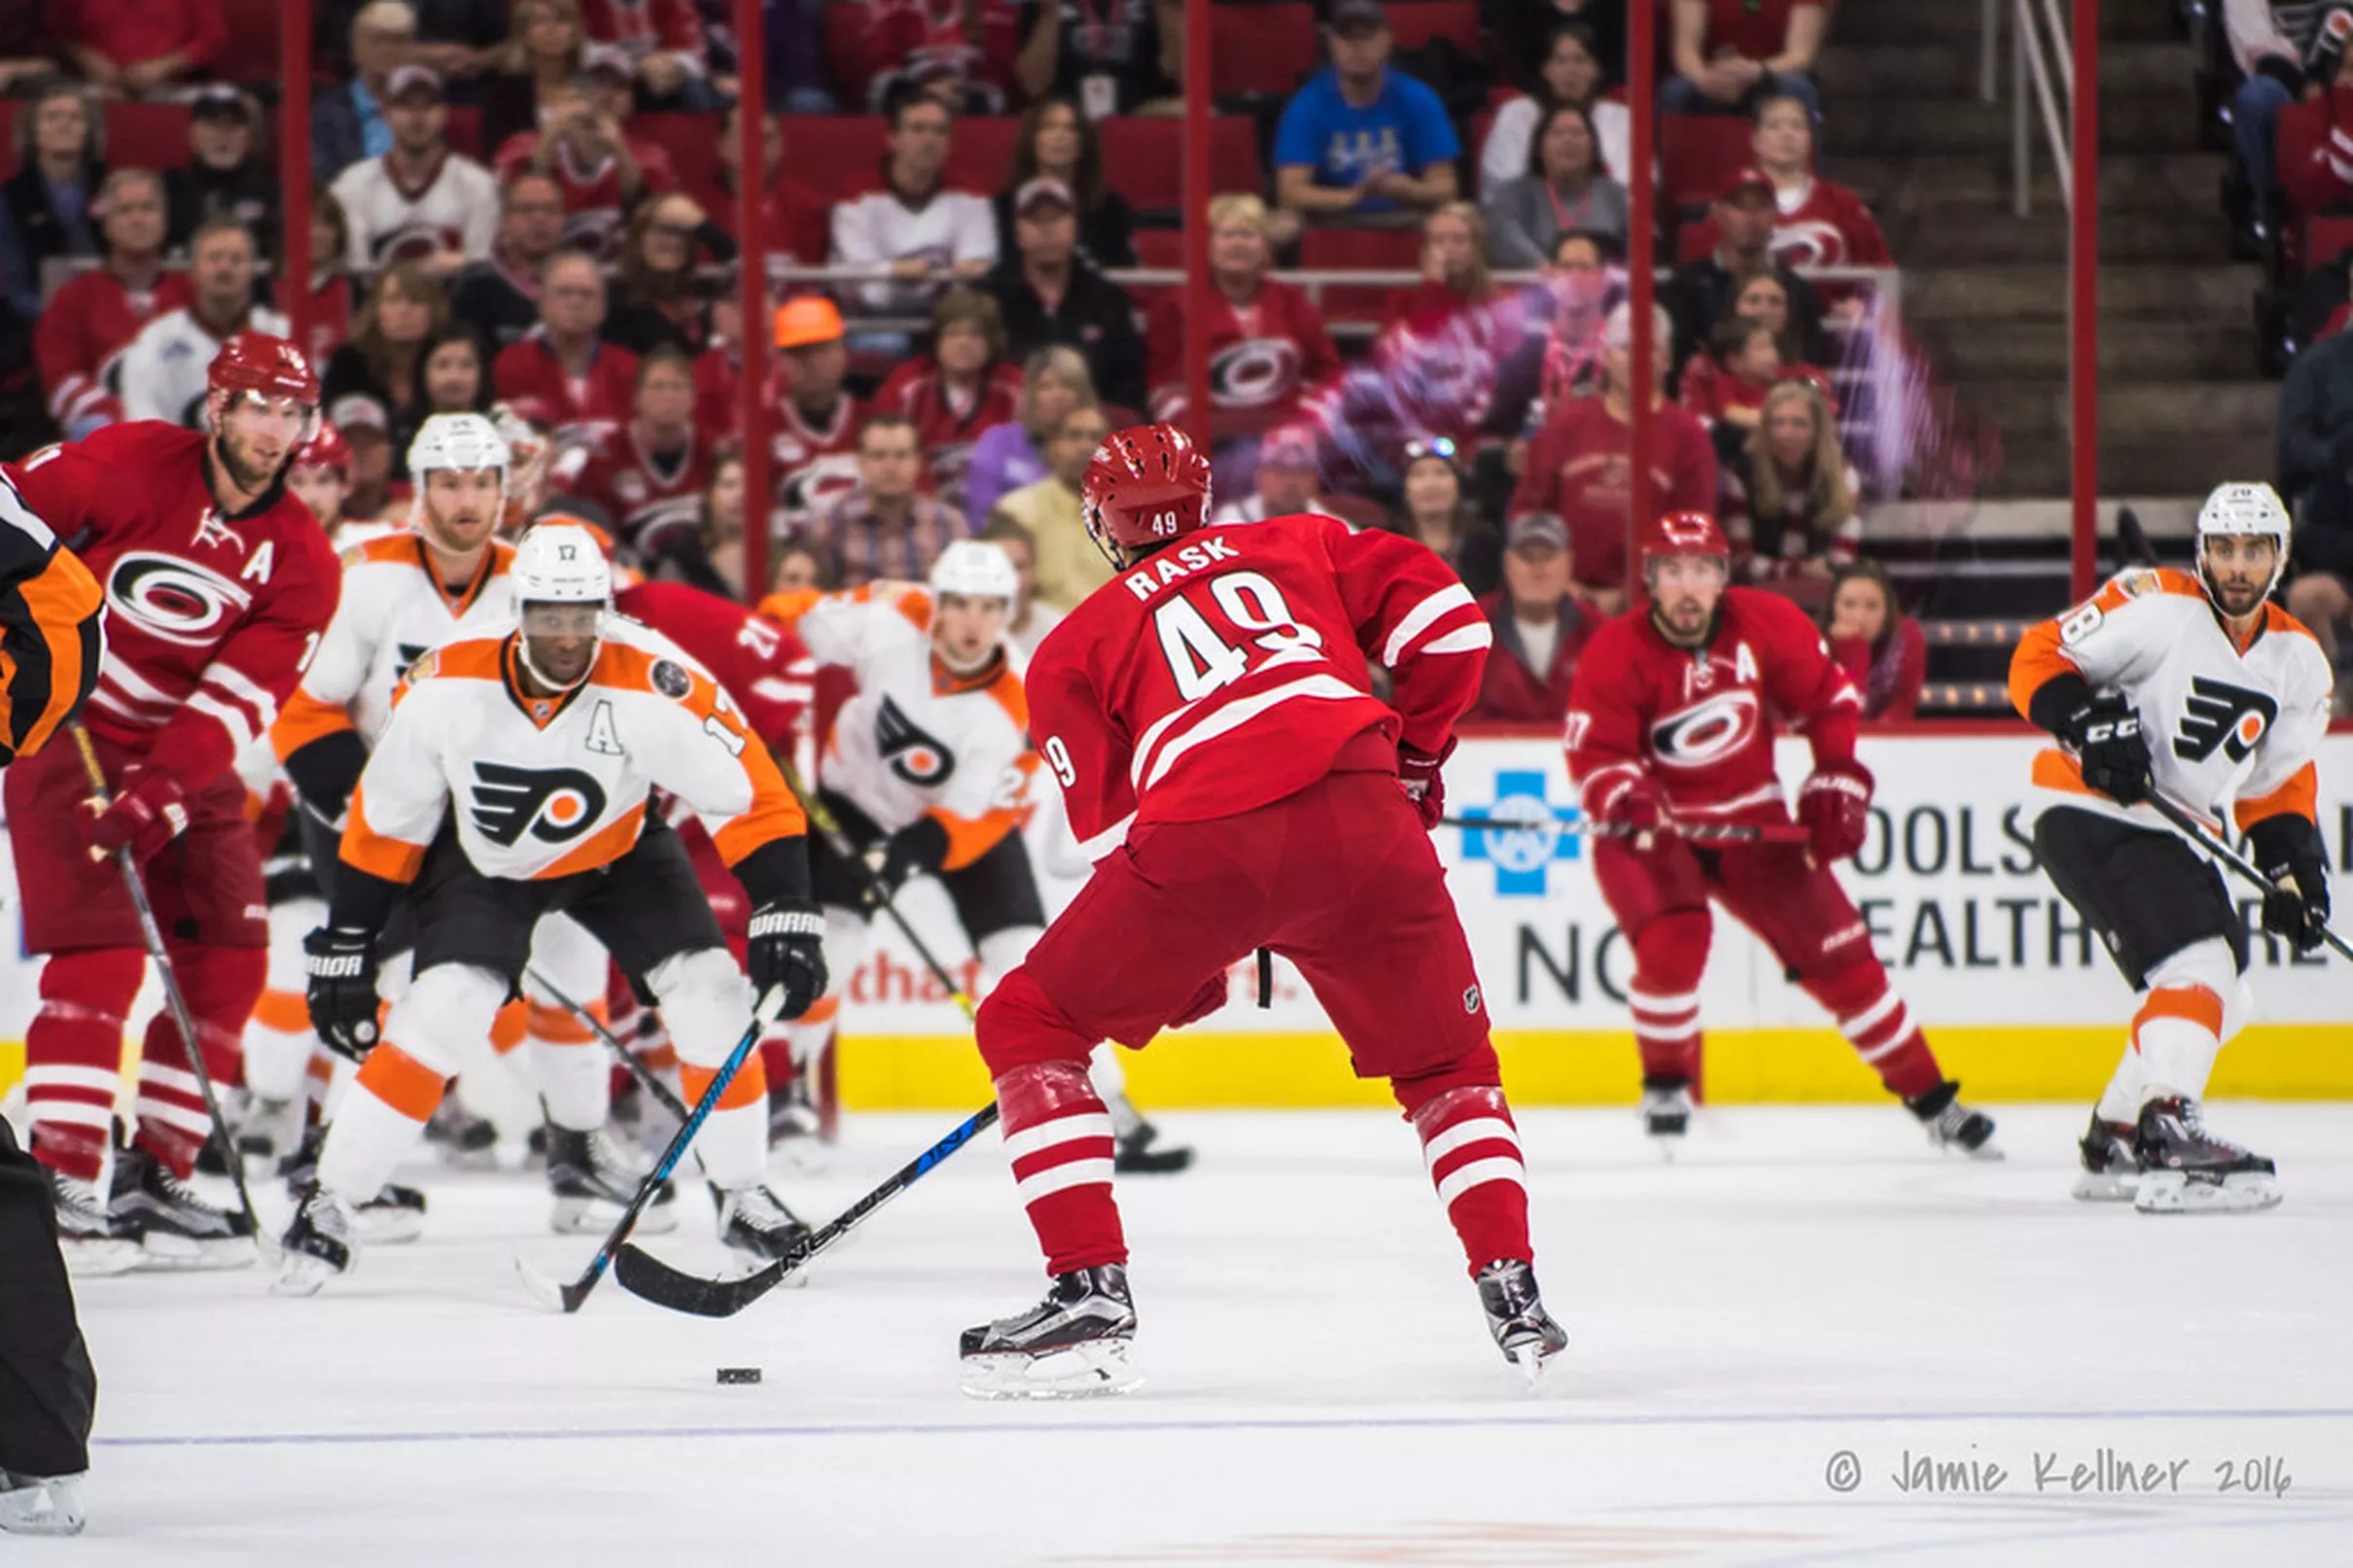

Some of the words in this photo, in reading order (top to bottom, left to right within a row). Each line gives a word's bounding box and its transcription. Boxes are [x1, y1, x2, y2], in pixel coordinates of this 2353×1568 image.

[1151, 510, 1177, 537] 49
[241, 540, 274, 584] A
[1124, 536, 1240, 602] RASK
[1152, 569, 1323, 703] 49
[1737, 642, 1759, 683] A
[585, 698, 624, 756] A
[2086, 716, 2138, 744] CC
[1041, 734, 1076, 788] 9
[1855, 805, 2040, 877] OOLS
[749, 911, 826, 939] WARR
[1859, 898, 2092, 968] EALTH
[308, 955, 364, 977] RIOR
